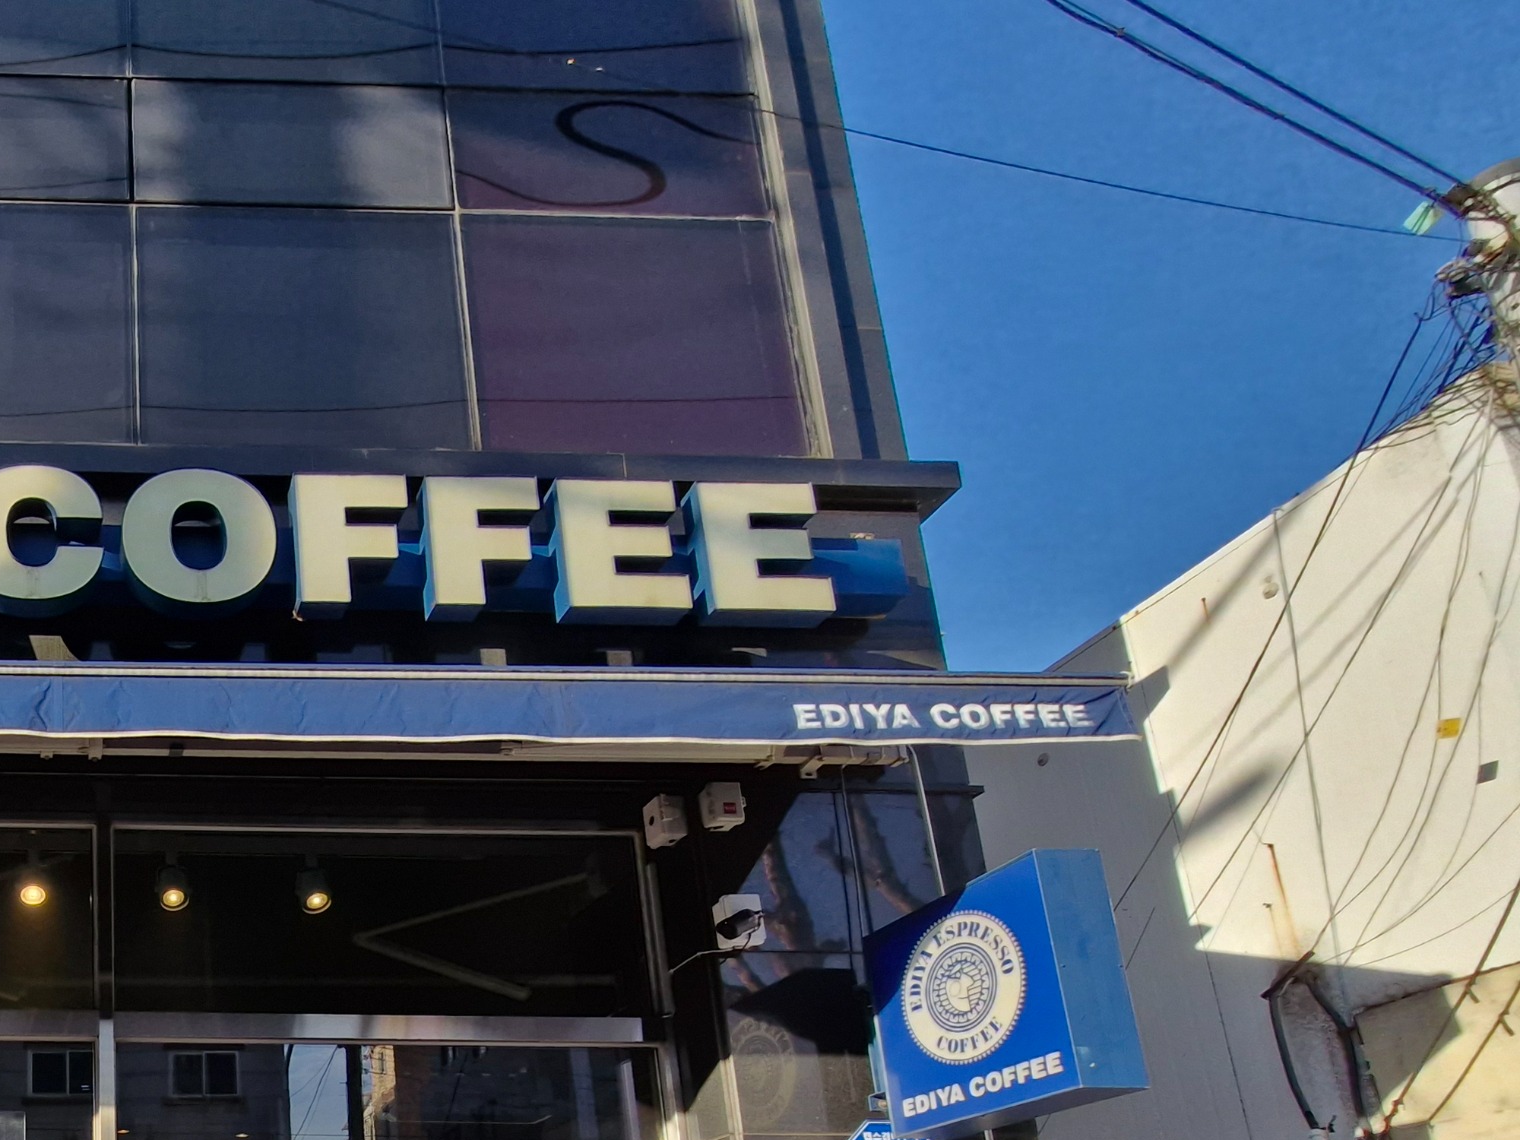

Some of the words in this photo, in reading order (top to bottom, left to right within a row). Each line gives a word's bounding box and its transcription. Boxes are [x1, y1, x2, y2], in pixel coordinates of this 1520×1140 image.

[792, 703, 921, 730] EDIYA
[929, 702, 1096, 730] COFFEE
[910, 949, 934, 1012] EDIYA
[933, 921, 1015, 976] ESPRESSO
[936, 1016, 1004, 1054] COFFEE
[902, 1083, 966, 1118] EDIYA
[968, 1051, 1065, 1098] COFFEE
